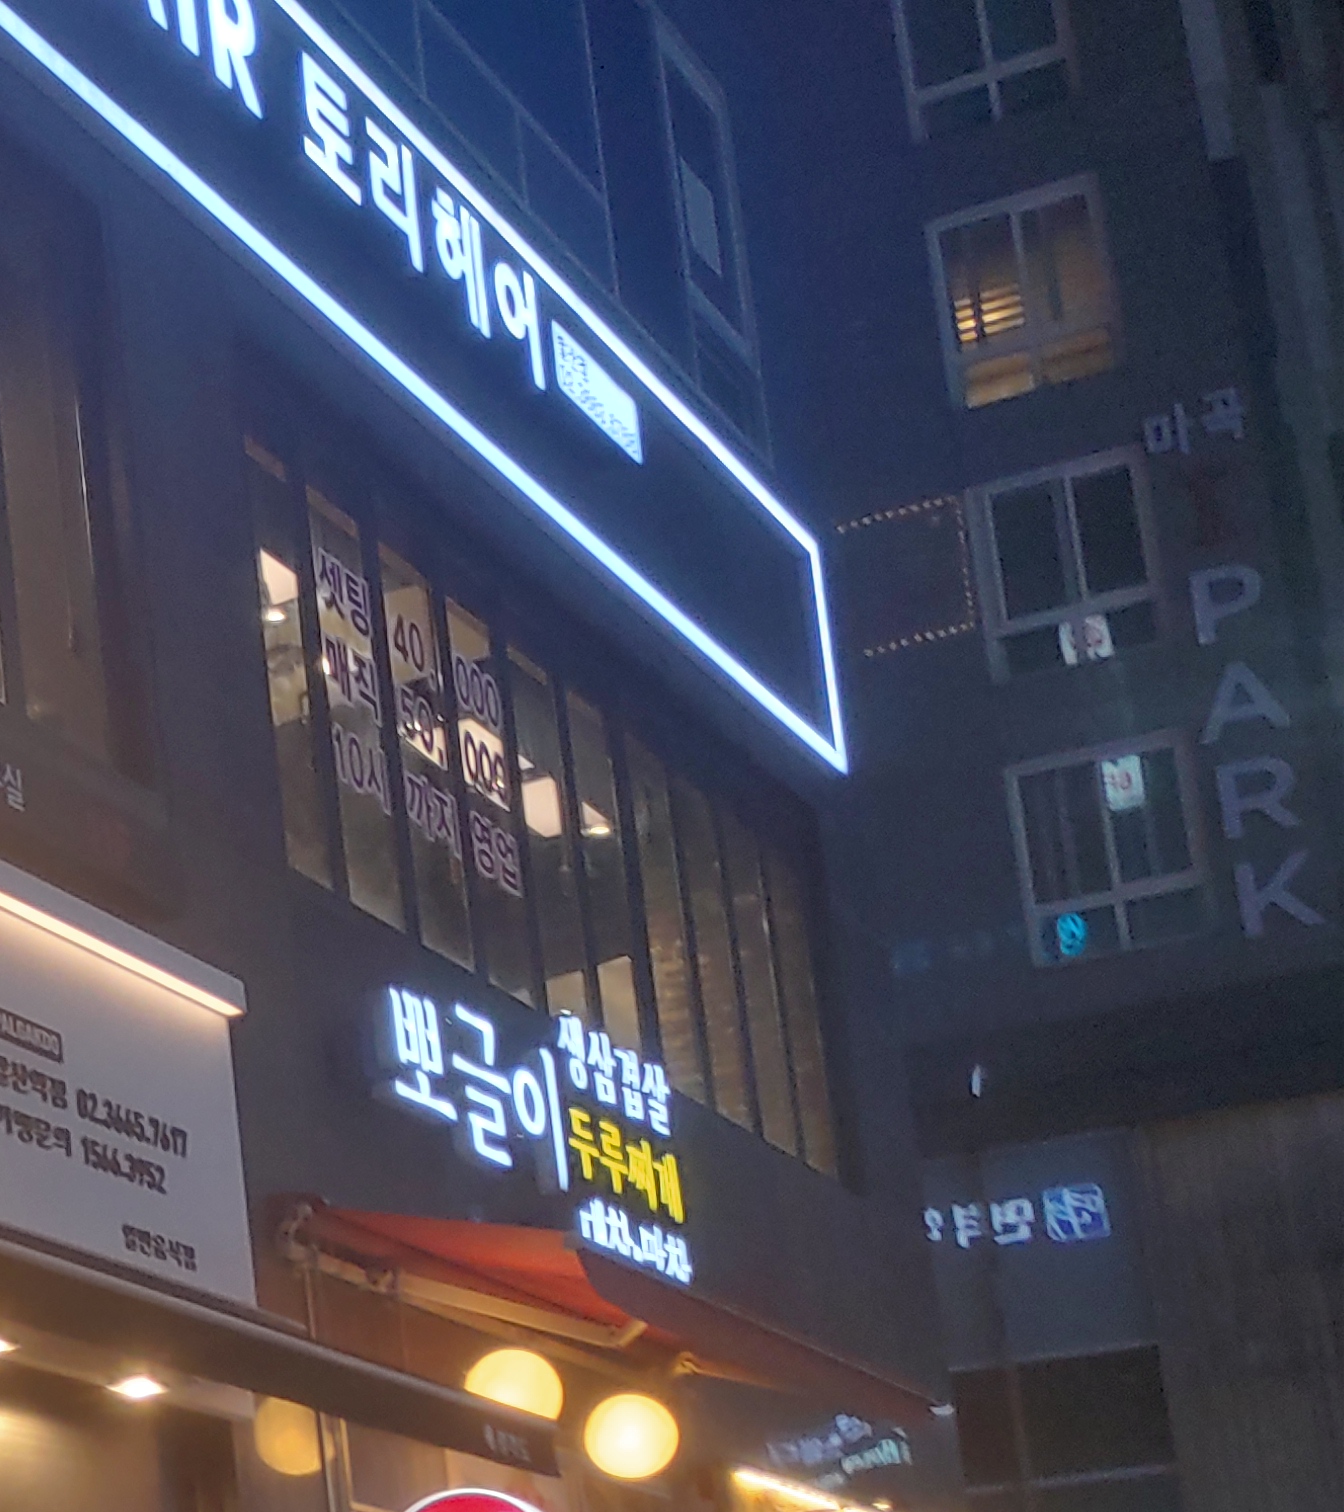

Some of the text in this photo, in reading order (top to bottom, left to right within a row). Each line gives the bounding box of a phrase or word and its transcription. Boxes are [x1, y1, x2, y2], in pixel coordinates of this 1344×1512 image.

[299, 49, 545, 391] 토리헤어
[331, 722, 390, 816] 10시
[470, 811, 524, 898] 영업
[1189, 565, 1327, 939] PARK
[389, 987, 568, 1191] 뽀글이
[558, 1014, 671, 1135] 생삼겹살
